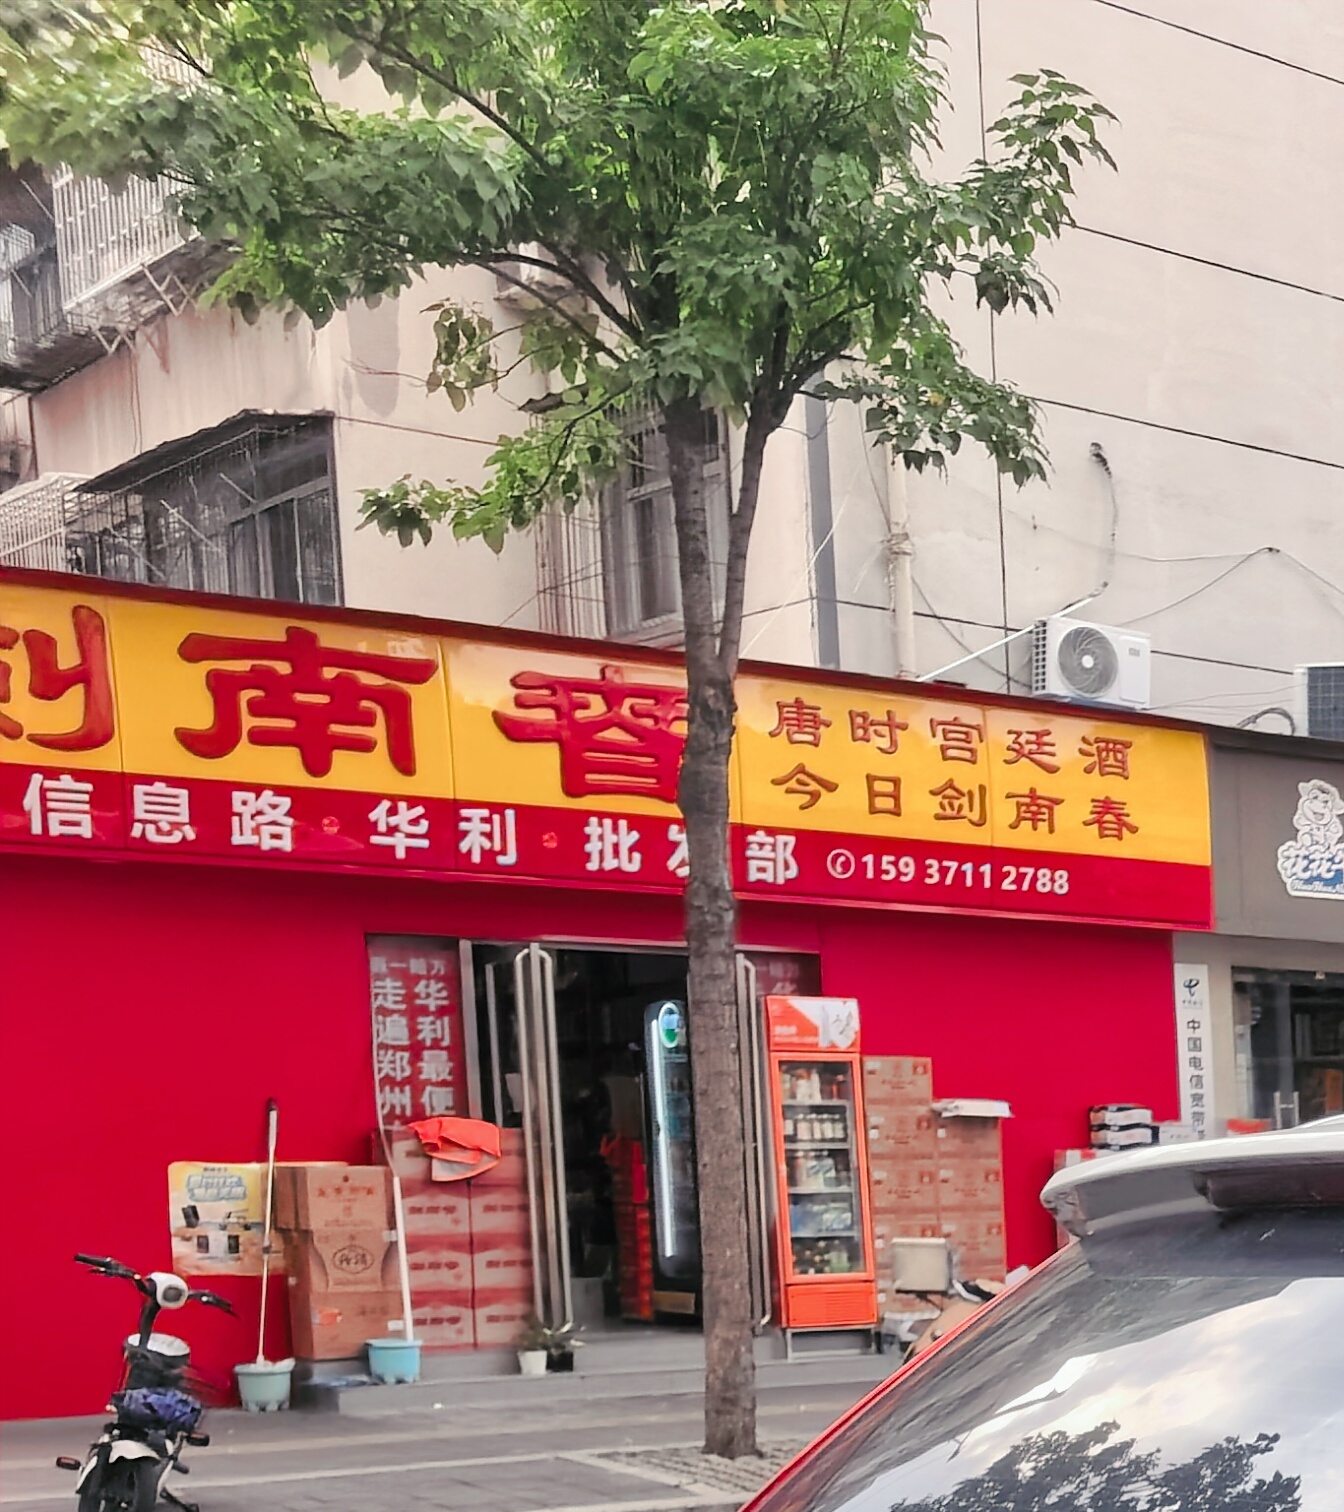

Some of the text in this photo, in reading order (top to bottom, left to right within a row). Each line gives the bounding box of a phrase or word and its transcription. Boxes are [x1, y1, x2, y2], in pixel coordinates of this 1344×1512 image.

[768, 697, 1133, 780] 唐时宫廷酒
[771, 763, 1139, 840] 今日剑南春
[862, 853, 1070, 894] 159 3711 2788
